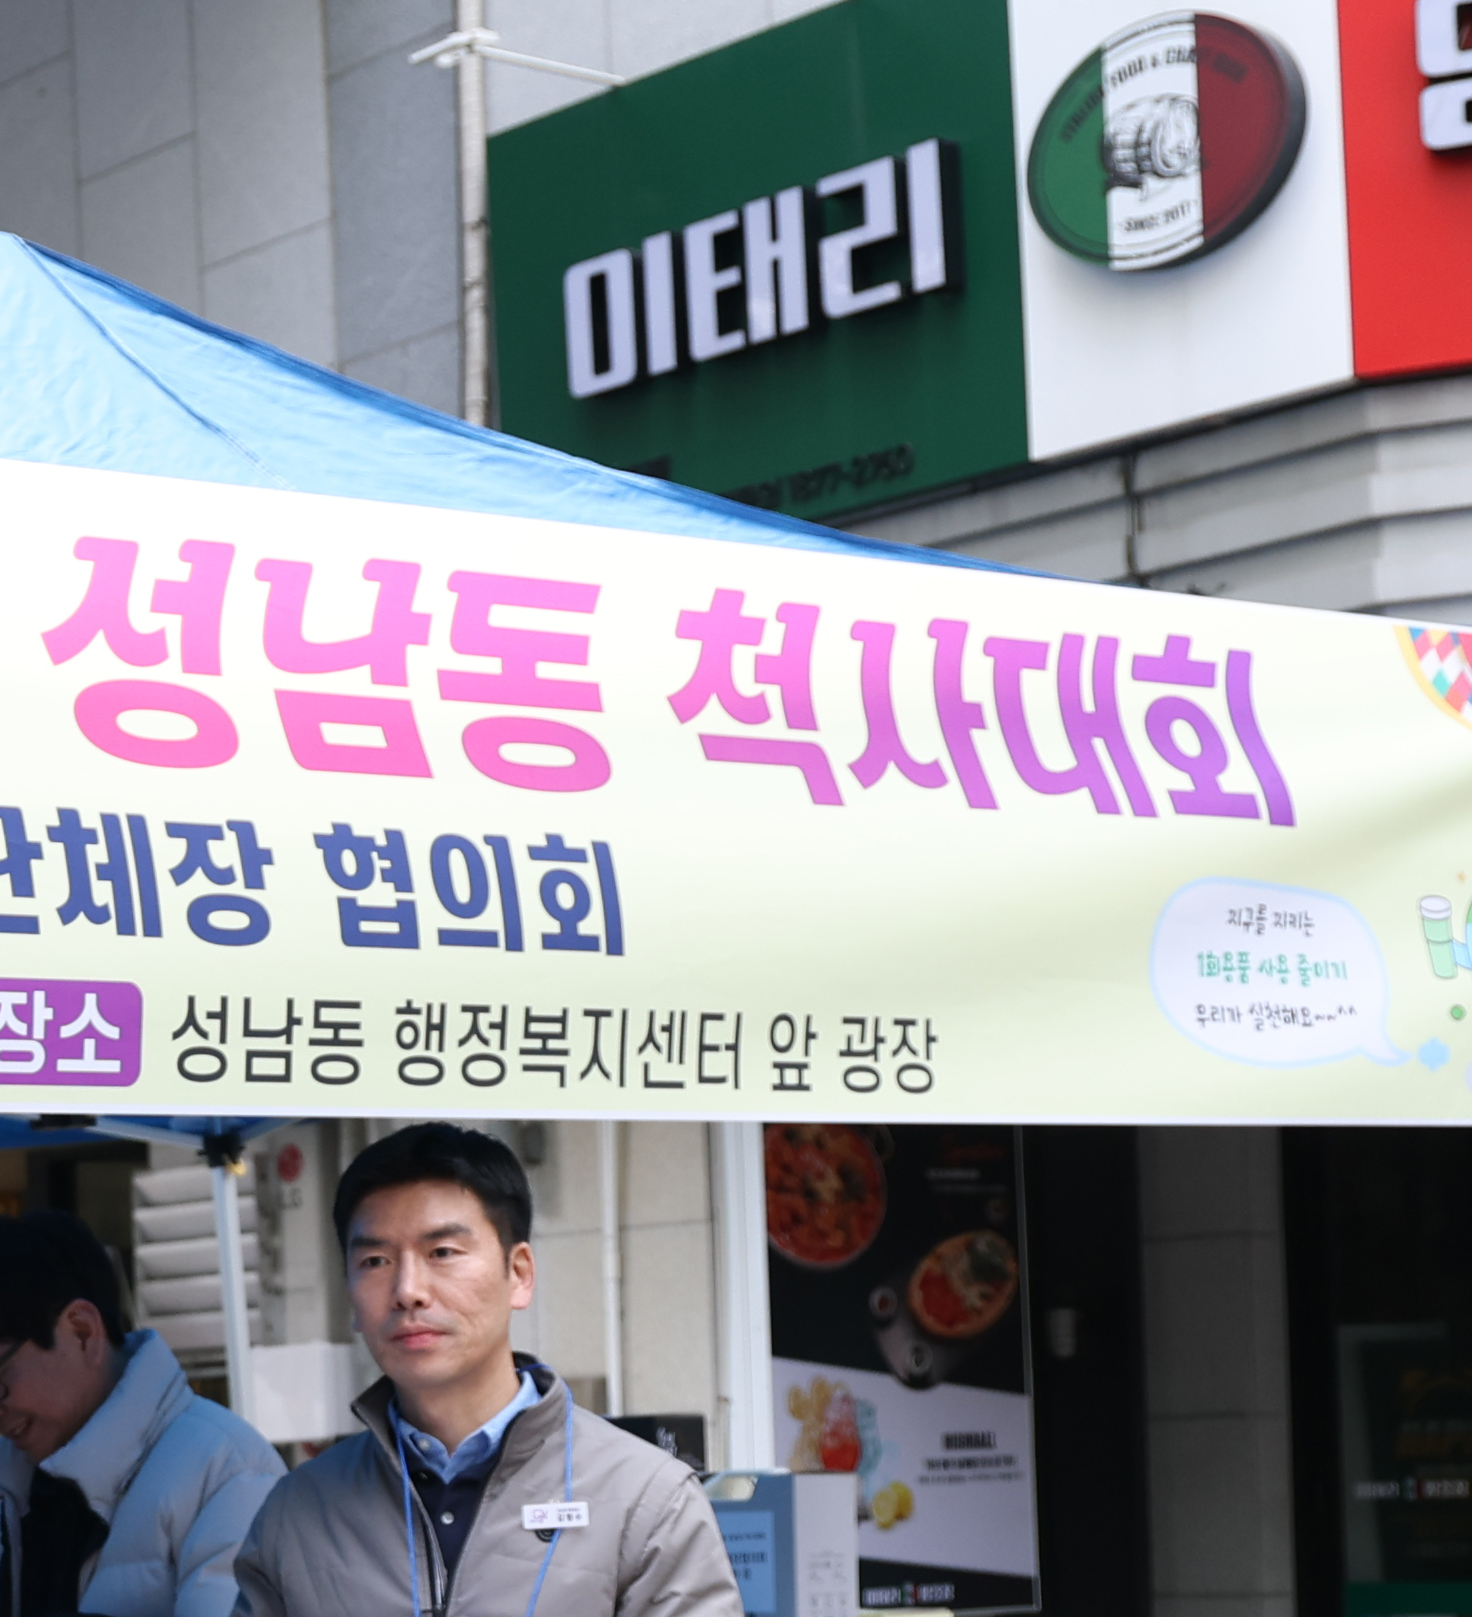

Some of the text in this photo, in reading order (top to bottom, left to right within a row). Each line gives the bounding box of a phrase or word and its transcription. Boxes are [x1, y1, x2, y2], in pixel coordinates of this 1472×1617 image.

[41, 535, 612, 794] 성남동
[667, 588, 1297, 828] 척사대회
[314, 820, 626, 957] 협의회
[1226, 903, 1316, 937] 지구를 지키는
[1258, 953, 1290, 985] 사용
[1296, 953, 1348, 987] 줄이기
[170, 995, 938, 1095] 성남동 행정복지센터 앞 광장
[1195, 1003, 1243, 1027] 우리가
